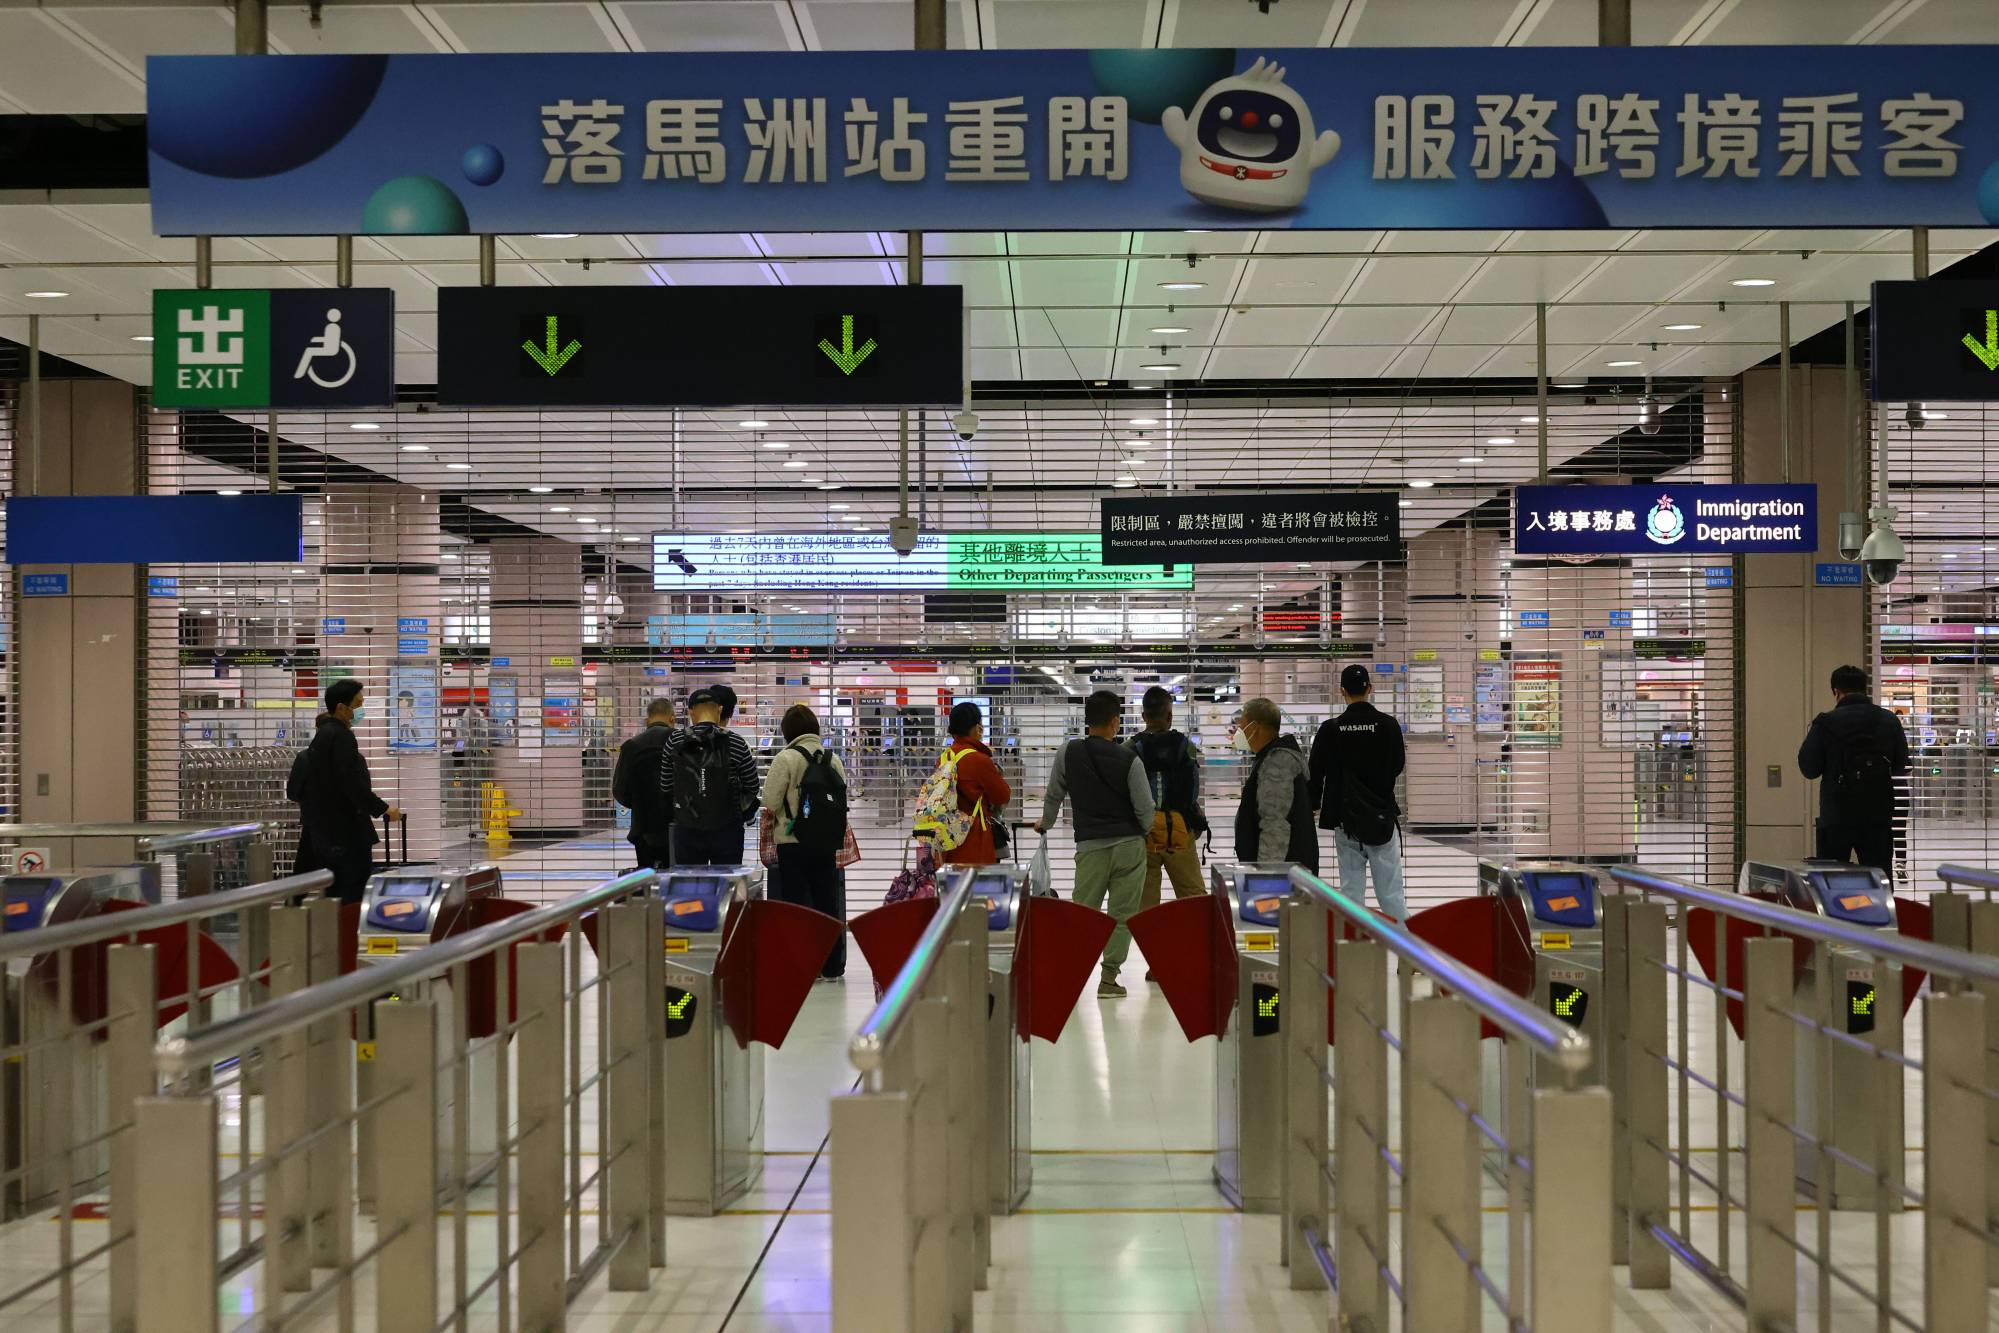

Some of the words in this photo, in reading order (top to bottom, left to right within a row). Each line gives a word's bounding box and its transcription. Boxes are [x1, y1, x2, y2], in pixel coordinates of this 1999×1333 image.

[540, 95, 1129, 185] 落馬洲站重開
[1371, 91, 1966, 179] 服務跨境乘客
[176, 368, 244, 389] EXIT
[1696, 499, 1804, 520] Immigration
[1525, 509, 1637, 532] 入境事務處
[1111, 539, 1148, 547] Restricted
[1168, 538, 1218, 546] unauthorized
[1244, 536, 1286, 545] prohibited.
[1286, 536, 1320, 544] Offender
[1321, 535, 1334, 543] will
[1335, 535, 1346, 543] be
[1346, 534, 1391, 544] prosecuted.
[1696, 523, 1801, 545] Department
[959, 542, 1091, 564] 其他離境人士
[959, 567, 1000, 580] Other
[1005, 567, 1074, 582] Departing
[1077, 567, 1153, 582] Passengers
